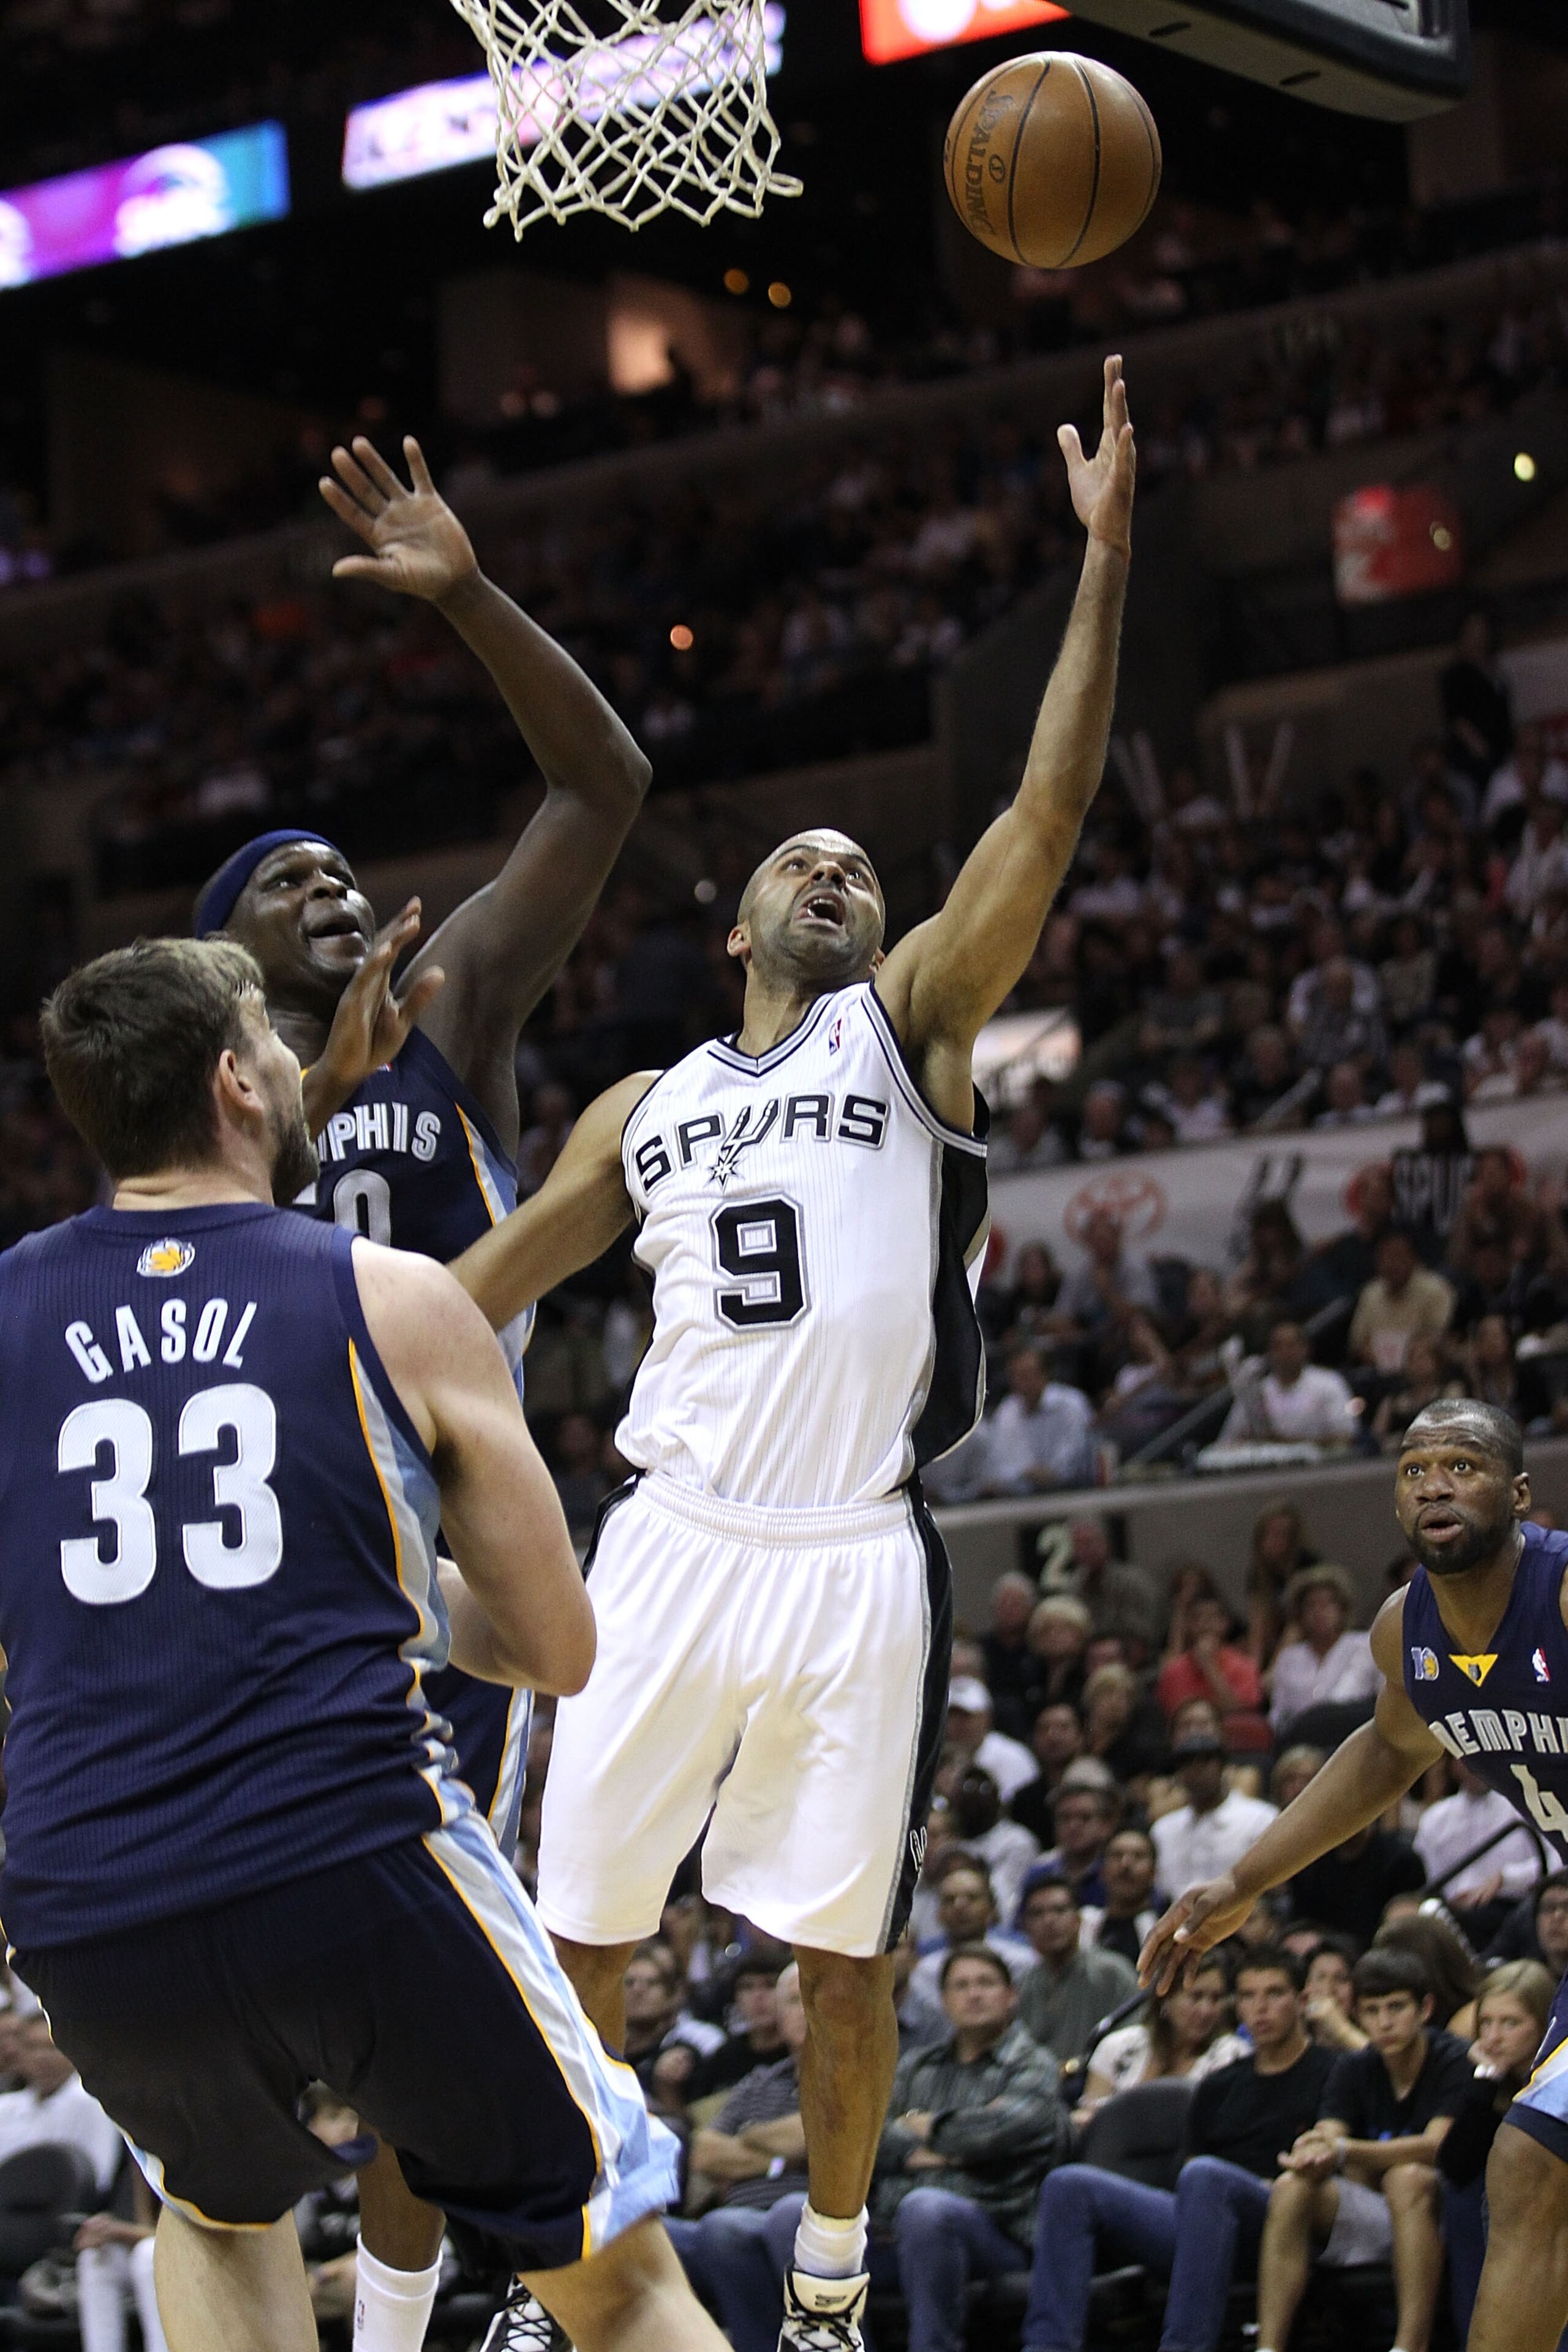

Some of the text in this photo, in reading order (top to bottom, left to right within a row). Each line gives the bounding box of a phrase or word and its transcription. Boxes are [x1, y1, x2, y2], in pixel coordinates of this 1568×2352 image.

[317, 1101, 442, 1162] PHIS
[635, 1092, 890, 1192] SPURS
[710, 1194, 812, 1333] 9
[64, 1298, 258, 1384] GASOL
[58, 1382, 284, 1605] 33
